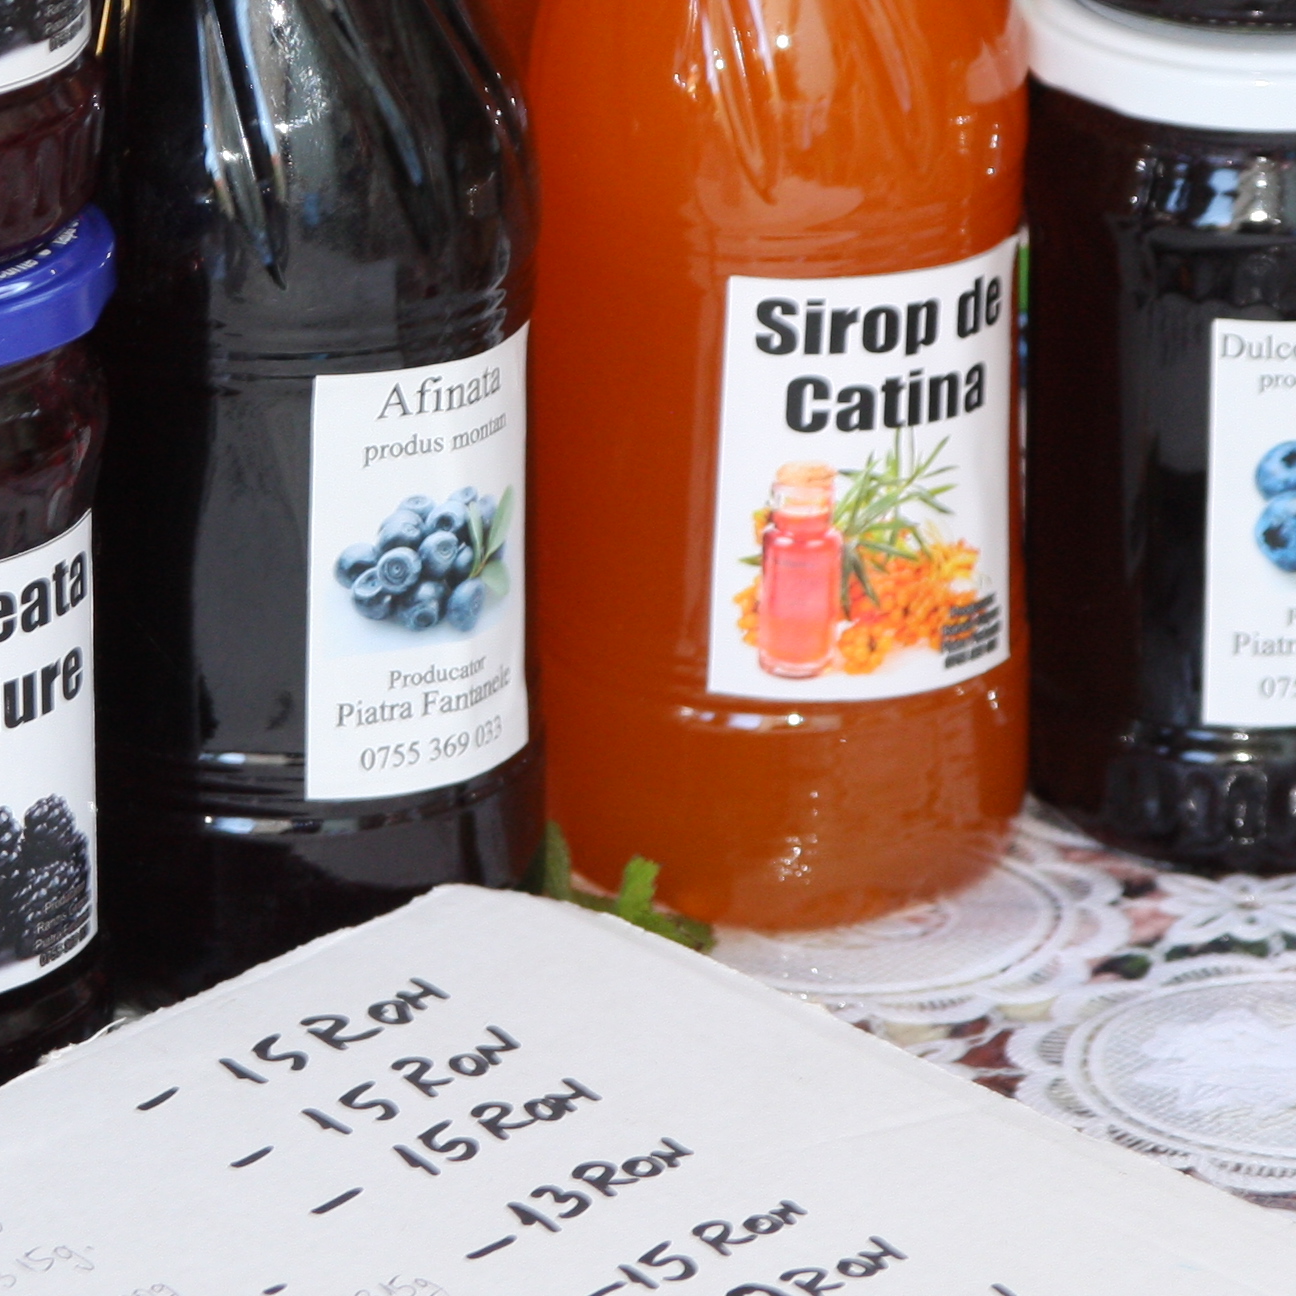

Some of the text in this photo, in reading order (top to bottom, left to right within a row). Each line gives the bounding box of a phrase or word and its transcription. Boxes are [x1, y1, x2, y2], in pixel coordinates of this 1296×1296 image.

[755, 275, 1002, 355] Sirop de
[377, 364, 502, 420] Afinata
[784, 361, 987, 433] Catina
[362, 411, 507, 468] produs montan
[336, 664, 510, 728] Piatra Fantanele
[388, 655, 486, 690] Producator
[360, 715, 503, 771] 0755 369 033
[218, 1032, 309, 1084] 15
[301, 1079, 401, 1135] 15
[392, 1119, 480, 1176] 15
